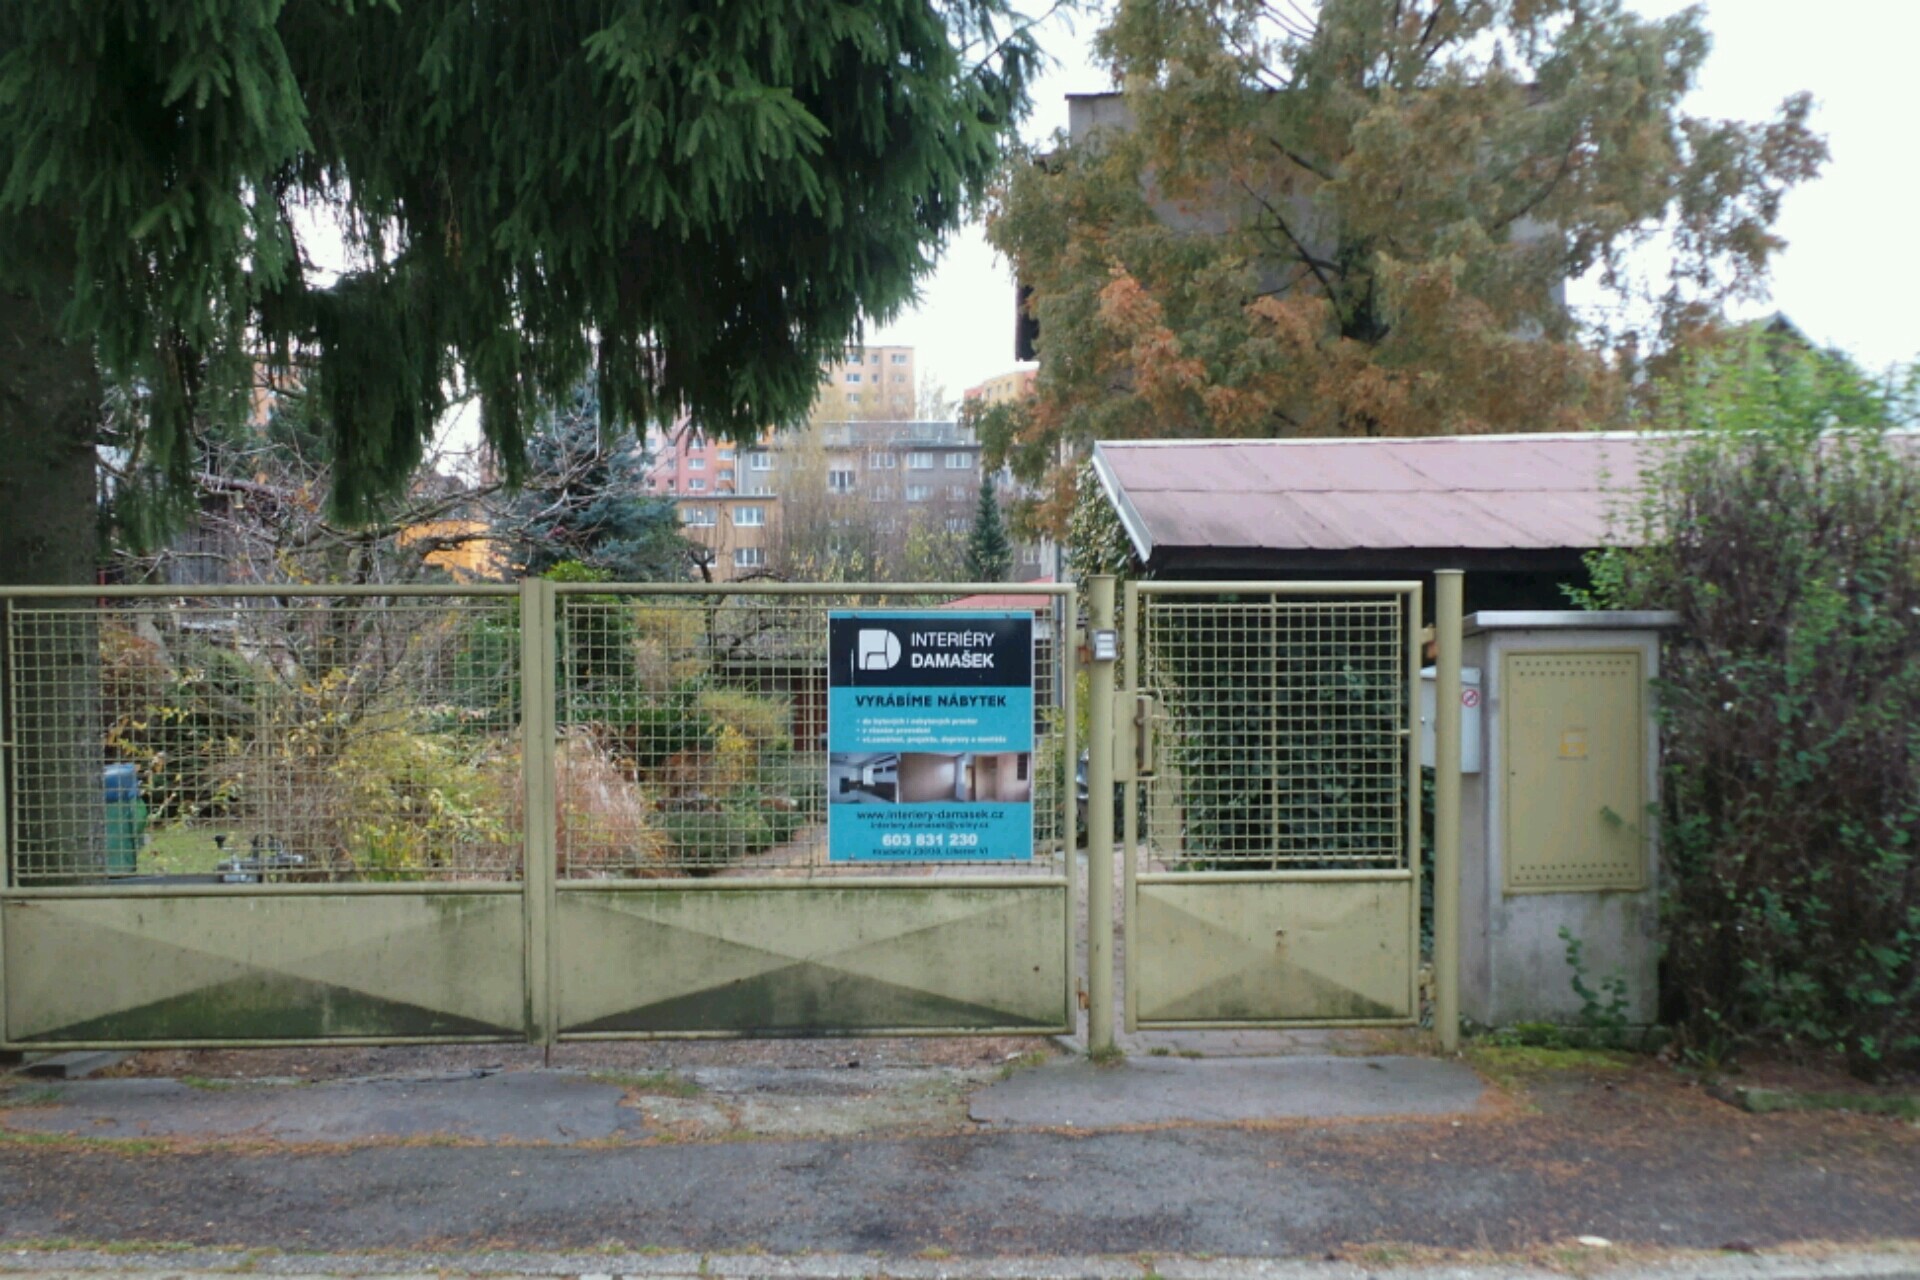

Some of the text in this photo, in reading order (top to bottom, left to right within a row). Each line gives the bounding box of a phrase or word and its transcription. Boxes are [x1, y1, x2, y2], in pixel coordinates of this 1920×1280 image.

[911, 630, 995, 647] INTERIÉRY
[911, 650, 995, 668] DAMAŠEK
[855, 692, 1007, 707] VYRÁBÍME NÁBYTEK
[882, 833, 911, 846] 603
[949, 833, 978, 846] 230
